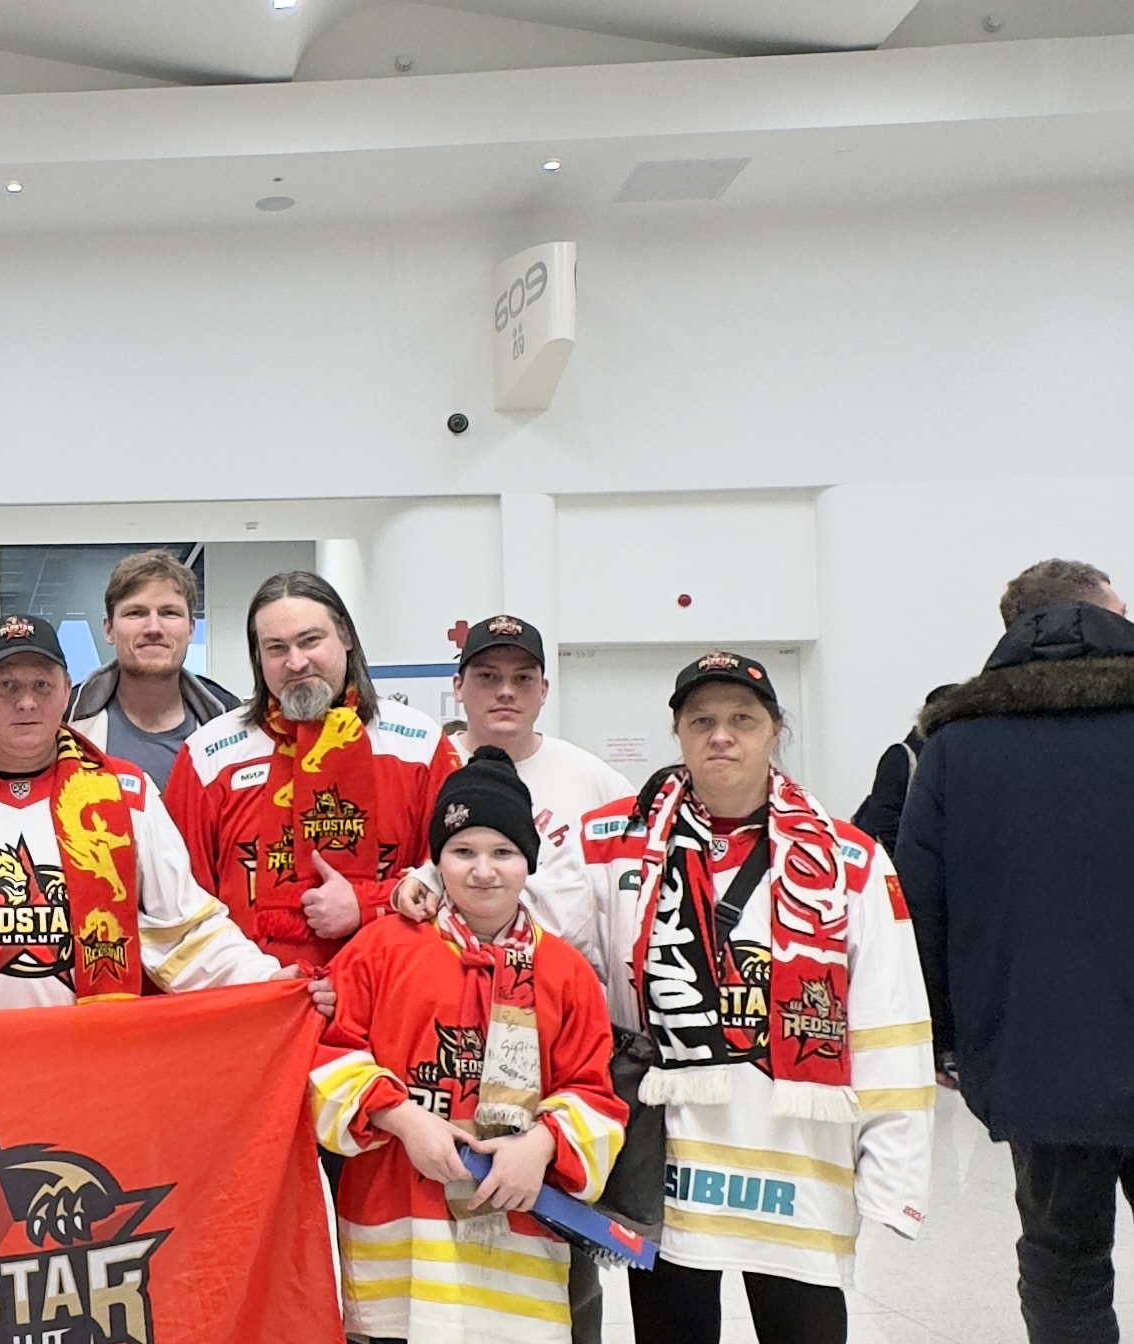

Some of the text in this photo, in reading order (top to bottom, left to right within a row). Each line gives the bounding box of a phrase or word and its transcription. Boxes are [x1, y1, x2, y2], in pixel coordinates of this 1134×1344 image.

[494, 260, 548, 333] 609
[302, 818, 365, 840] REDSTAR
[665, 1164, 796, 1217] SIBUR
